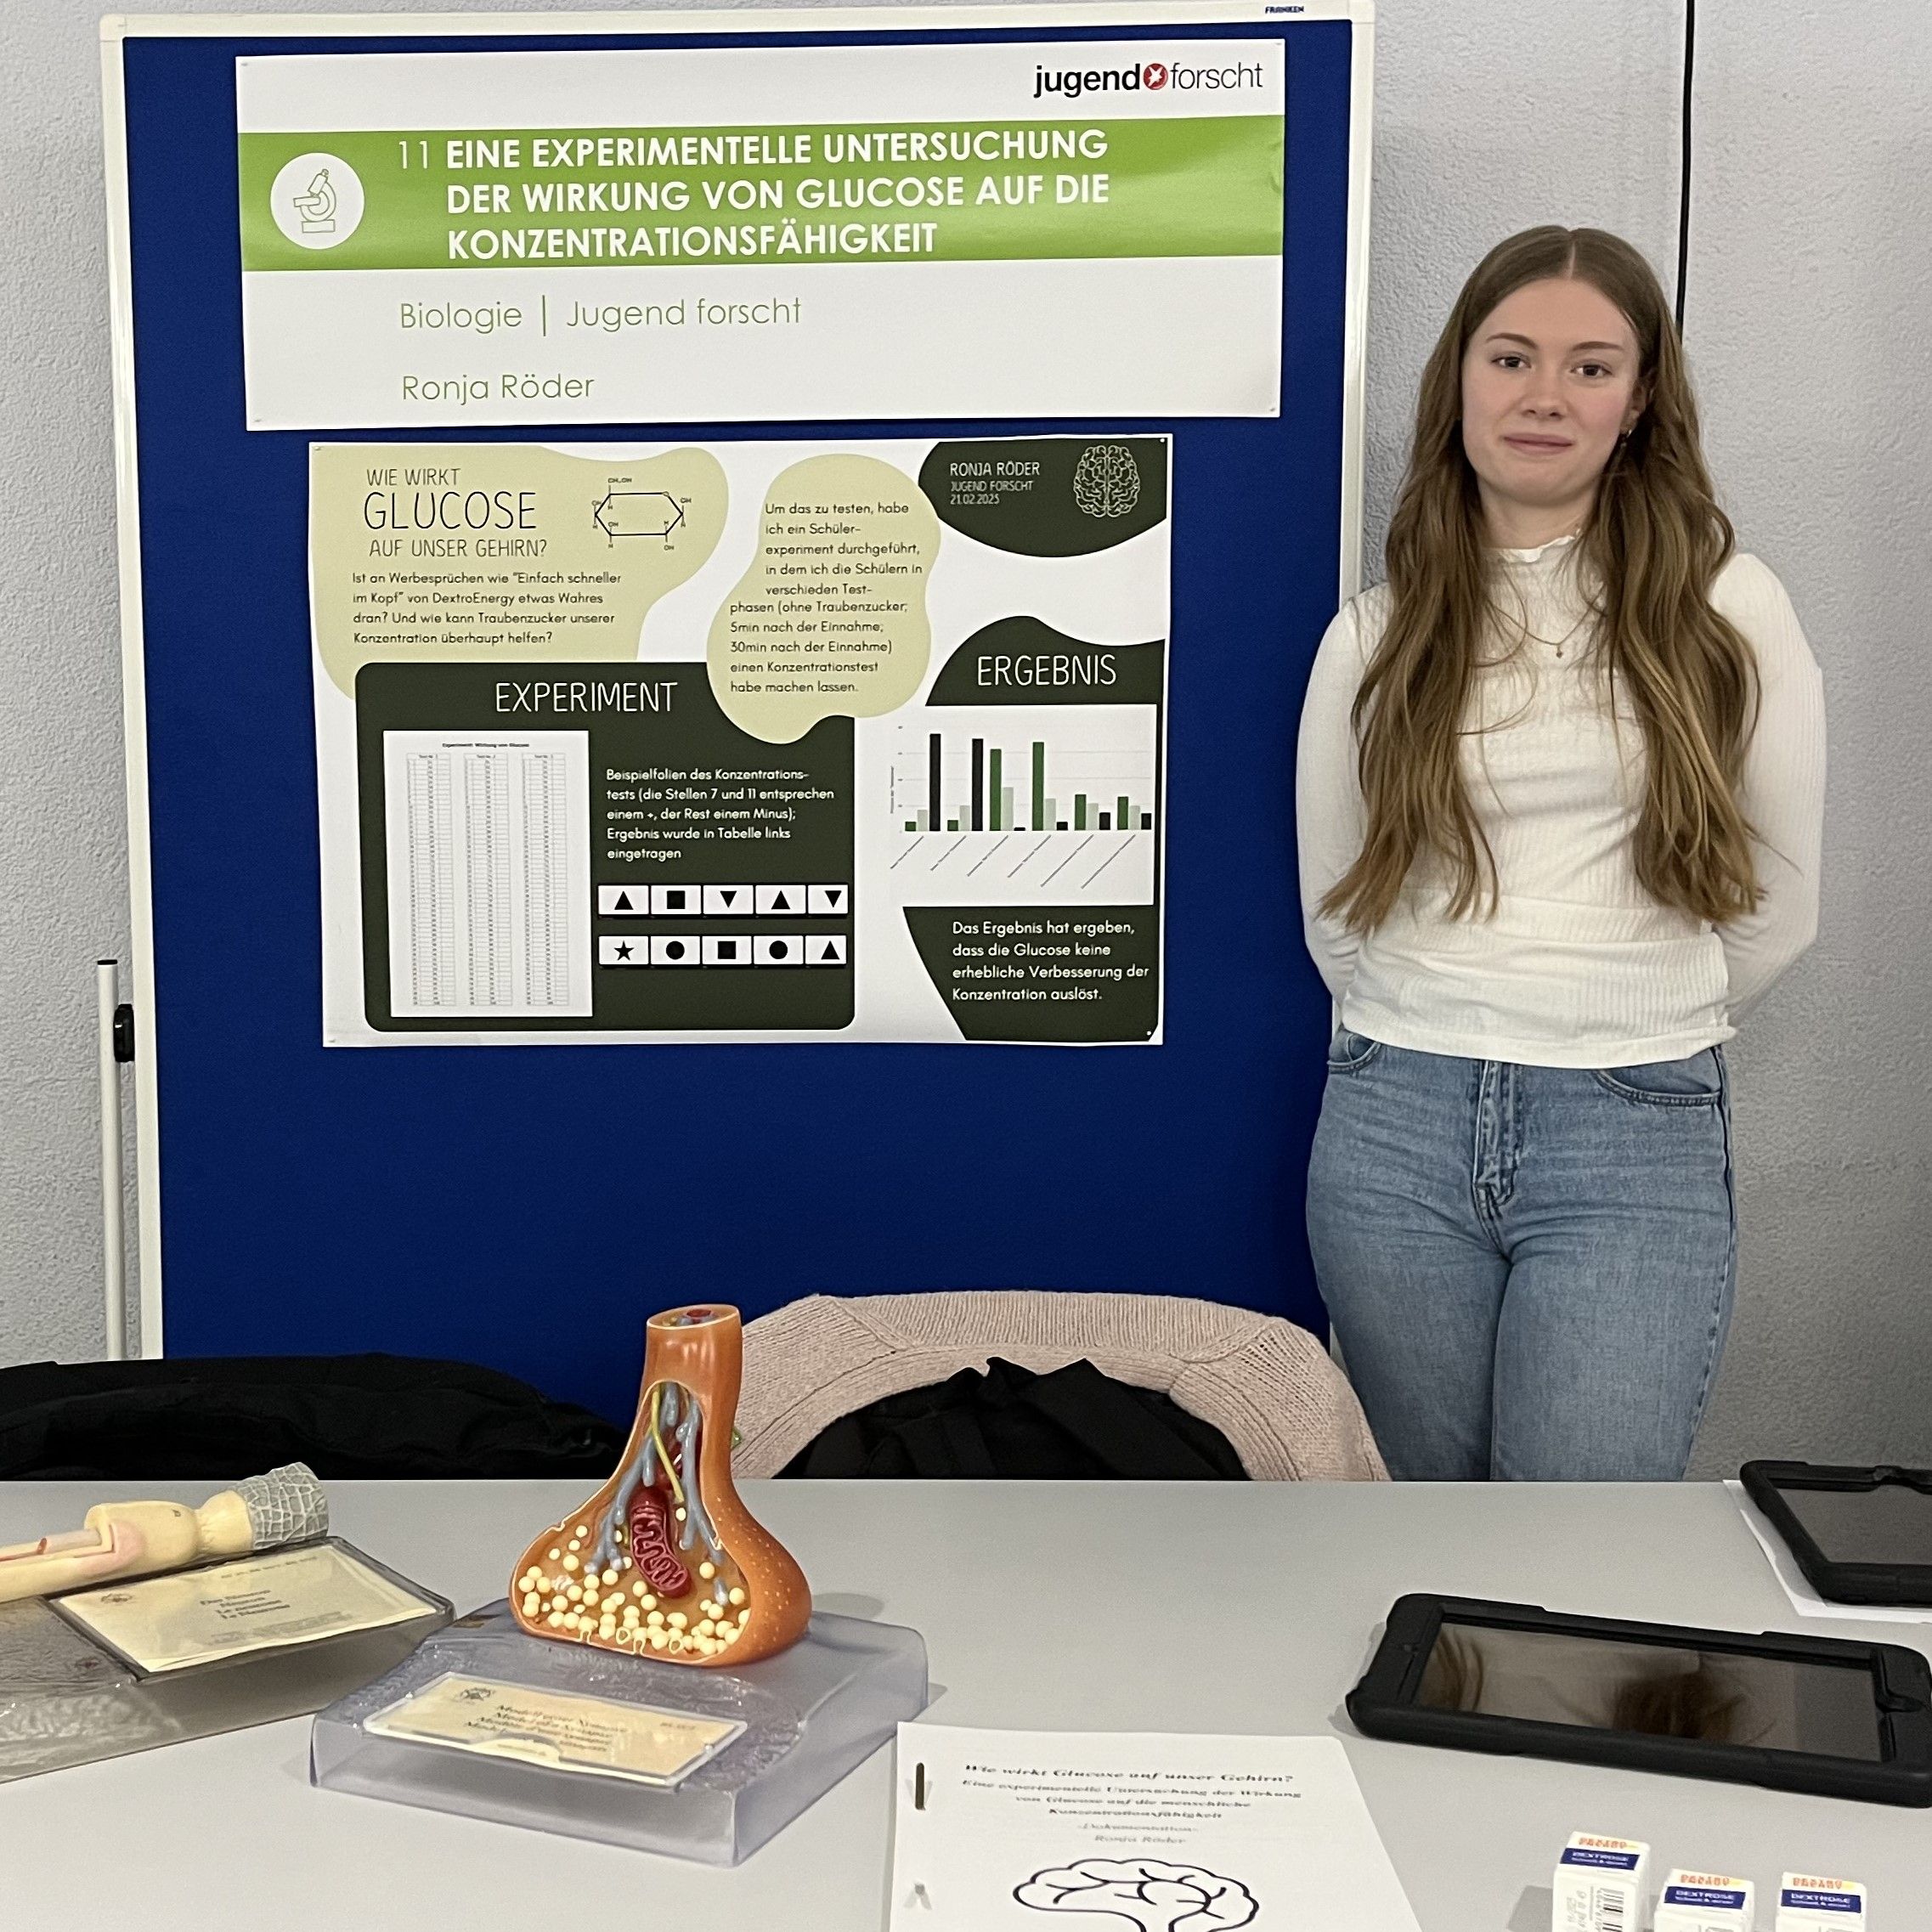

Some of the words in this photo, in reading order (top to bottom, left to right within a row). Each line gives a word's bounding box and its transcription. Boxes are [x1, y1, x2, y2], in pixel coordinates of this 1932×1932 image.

[1033, 65, 1140, 98] jugend
[1170, 62, 1263, 89] forscht
[398, 140, 428, 169] 11
[447, 138, 520, 169] EINE
[533, 134, 811, 167] EXPERIMENTELLE
[823, 128, 1108, 163] UNTERSUCHUNG
[447, 184, 511, 214] DER
[522, 181, 690, 213] WIRKUNG
[701, 179, 783, 210] VON
[796, 176, 964, 209] GLUCOSE
[974, 175, 1043, 206] AUF
[1056, 173, 1109, 204] DIE
[449, 217, 938, 260] KONZENTRATIONSFÄHIGKEIT
[400, 301, 523, 335] Biologie
[566, 298, 685, 333] Jugend
[696, 297, 801, 325] forscht
[403, 374, 489, 406] Ronja
[501, 373, 595, 398] Röder
[950, 462, 992, 477] RONJA
[997, 460, 1040, 477] RÖDER
[366, 468, 398, 487] WIE
[404, 467, 461, 486] WIRKT
[951, 480, 987, 492] JUGEND
[989, 480, 1034, 492] FORSCHT
[950, 493, 1000, 506] 21.02.2025
[364, 490, 537, 530] GLUCOSE
[765, 503, 786, 515] Um
[788, 502, 811, 515] das
[814, 506, 829, 515] zu
[833, 503, 874, 516] testen,
[878, 500, 909, 514] habe
[765, 522, 783, 535] ich
[787, 526, 806, 535] ein
[809, 522, 861, 535] Schüler-
[369, 539, 404, 557] AUF
[411, 539, 468, 557] UNSER
[475, 539, 547, 558] GEHIRN?
[765, 544, 834, 558] experiment
[837, 541, 920, 558] durchgeführt,
[765, 567, 777, 575] in
[780, 562, 807, 575] dem
[811, 562, 829, 575] ich
[832, 562, 852, 575] die
[855, 562, 908, 575] Schülern
[912, 564, 923, 573] in
[352, 572, 367, 584] Ist
[370, 575, 386, 584] an
[388, 571, 484, 587] Werbesprüchen
[487, 573, 510, 584] wie
[567, 571, 621, 584] schneller
[765, 582, 839, 596] verschieden
[842, 583, 873, 595] Test-
[353, 595, 367, 603] im
[407, 595, 429, 604] von
[432, 591, 515, 607] DextroEnergy
[517, 593, 556, 604] etwas
[557, 591, 604, 604] Wahres
[730, 601, 775, 616] phasen
[777, 600, 812, 615] (ohne
[353, 611, 388, 624] dran?
[392, 612, 417, 624] Und
[420, 613, 442, 624] wie
[445, 612, 475, 624] kann
[477, 611, 568, 624] Traubenzucker
[570, 615, 615, 624] unserer
[730, 621, 760, 633] 5min
[763, 620, 794, 633] nach
[796, 619, 818, 633] der
[353, 632, 438, 644] Konzentration
[441, 631, 505, 647] überhaupt
[507, 630, 553, 644] helfen?
[730, 641, 767, 653] 30min
[770, 640, 801, 652] nach
[804, 641, 825, 652] der
[828, 639, 892, 655] Einnahme)
[730, 664, 764, 673] einen
[767, 661, 878, 673] Konzentrationstest
[977, 653, 1116, 686] ERGEBNIS
[730, 680, 762, 692] habe
[765, 680, 814, 692] machen
[817, 680, 858, 692] lassen.
[495, 681, 678, 713] EXPERIMENT
[606, 767, 687, 783] Beispielfolien
[689, 767, 712, 781] des
[715, 768, 810, 780] Konzentrations-
[606, 789, 636, 800] tests
[638, 788, 663, 803] (die
[665, 787, 708, 800] Stellen
[710, 788, 719, 799] 7
[721, 787, 744, 799] und
[747, 788, 756, 799] 11
[759, 787, 834, 803] entsprechen
[607, 811, 644, 820] einem
[660, 807, 681, 820] der
[684, 807, 710, 820] Rest
[713, 809, 751, 820] einem
[753, 806, 796, 822] Minus);
[607, 827, 660, 843] Ergebnis
[662, 826, 701, 839] wurde
[703, 828, 715, 839] in
[717, 826, 762, 839] Tabelle
[765, 826, 791, 839] links
[607, 848, 681, 862] eingetragen
[952, 921, 980, 935] Das
[983, 920, 1043, 938] Ergebnis
[1047, 919, 1070, 934] hat
[1073, 919, 1135, 938] ergeben,
[952, 942, 985, 957] dass
[987, 942, 1010, 957] die
[1014, 942, 1071, 957] Glucose
[1075, 941, 1111, 956] keine
[952, 964, 1025, 979] erhebliche
[1028, 963, 1122, 981] Verbesserung
[1126, 963, 1150, 977] der
[952, 987, 1047, 1001] Konzentration
[1050, 986, 1103, 1000] auslöst.
